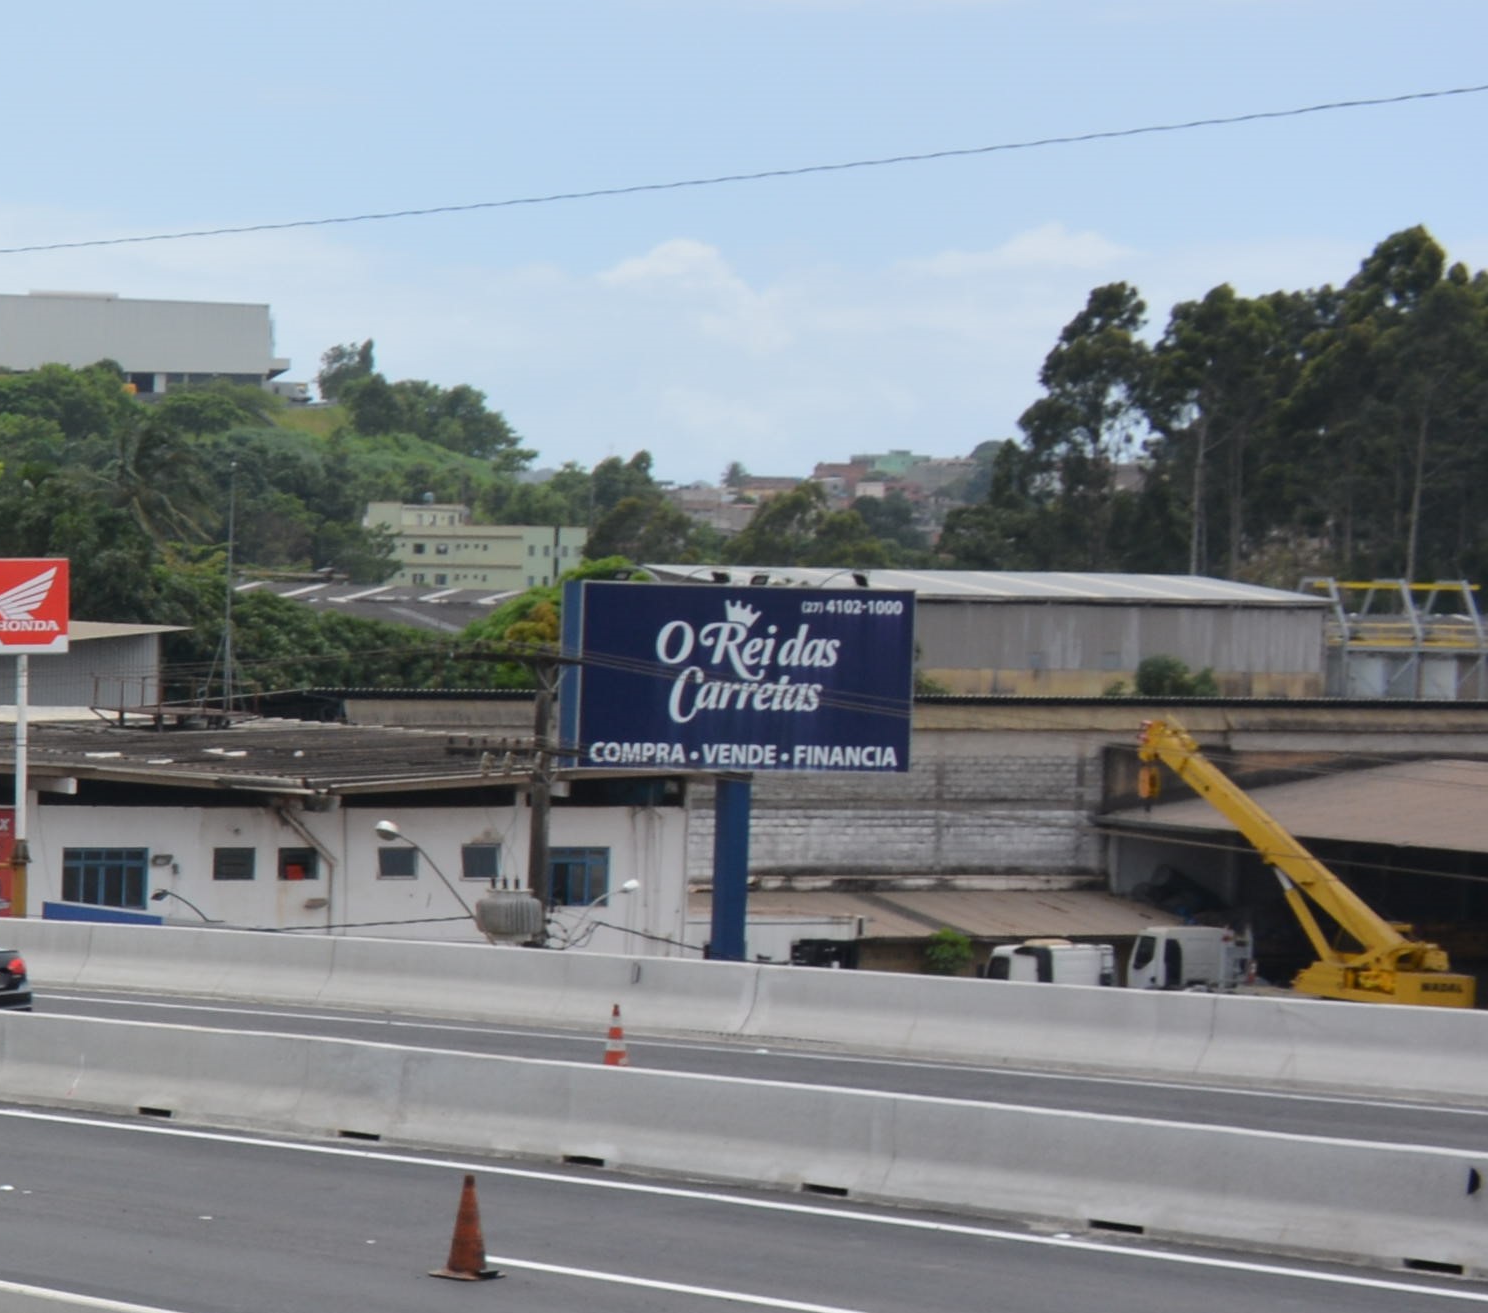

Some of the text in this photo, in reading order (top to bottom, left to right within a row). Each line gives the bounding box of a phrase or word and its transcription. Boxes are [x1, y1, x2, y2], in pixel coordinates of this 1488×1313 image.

[801, 599, 904, 615] (27) 4102-1000
[656, 620, 841, 681] O Rei das
[668, 666, 823, 724] Carretas
[590, 741, 898, 767] COMPRA VENDE FINANCIA
